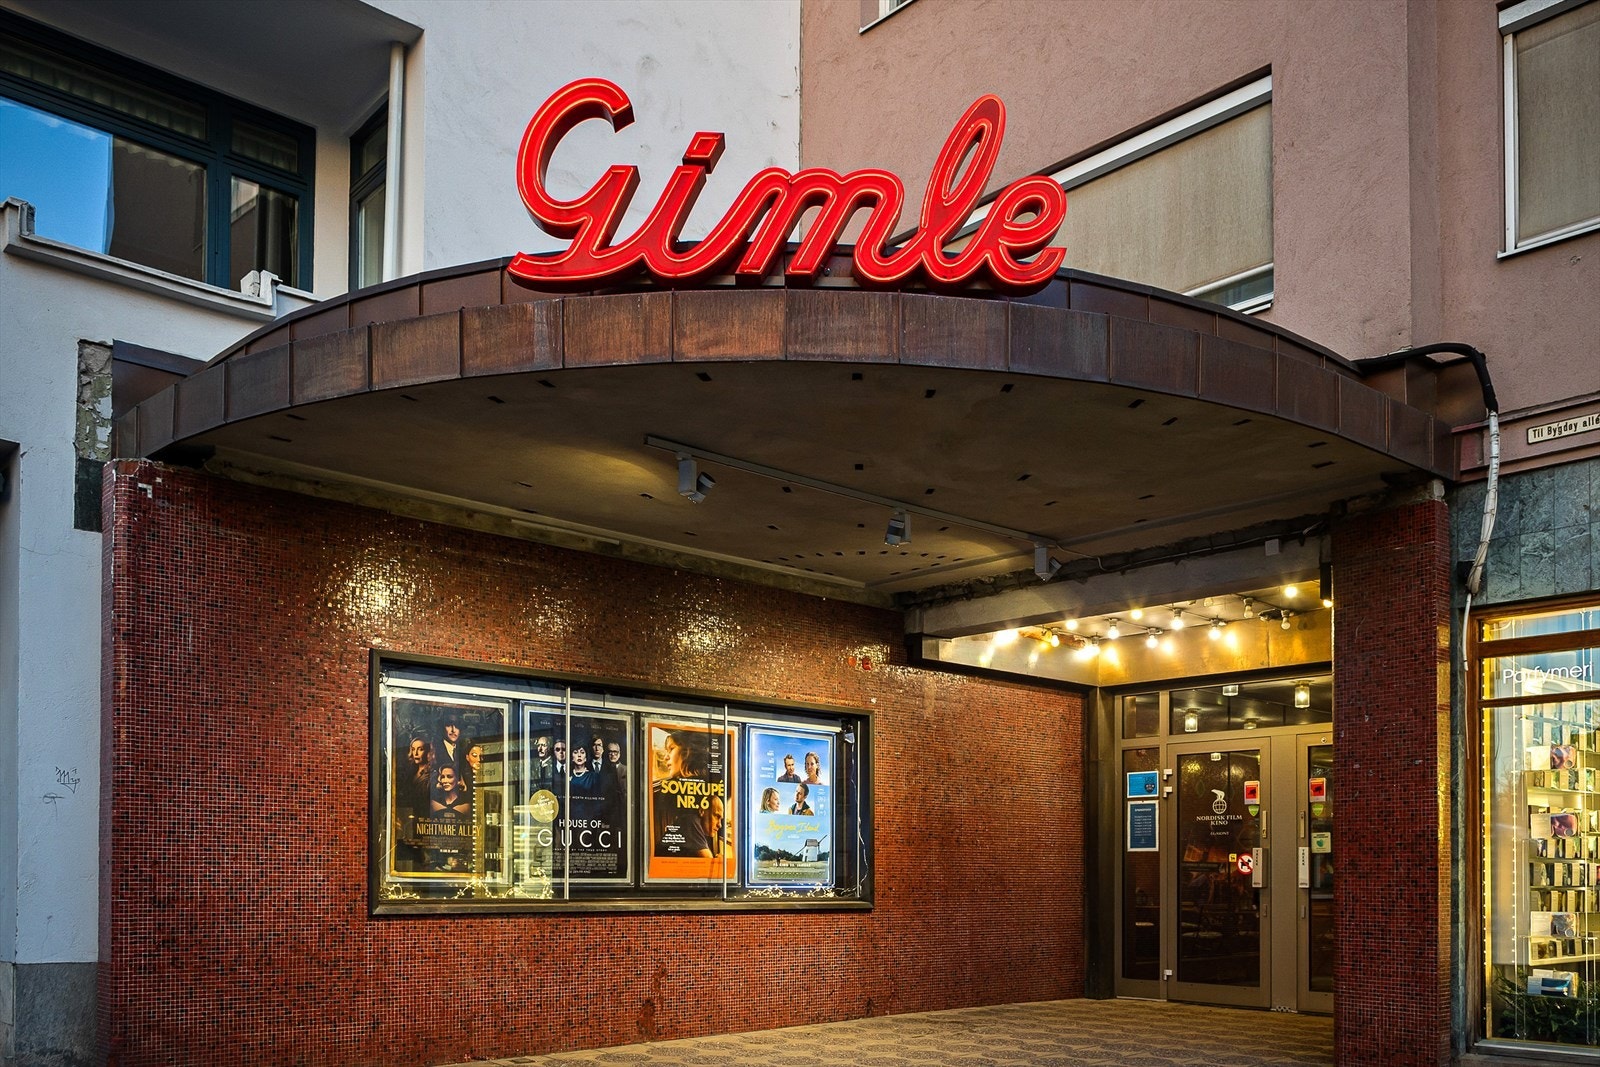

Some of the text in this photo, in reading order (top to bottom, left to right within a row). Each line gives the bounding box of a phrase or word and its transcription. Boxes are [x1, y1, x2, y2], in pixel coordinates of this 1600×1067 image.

[507, 78, 1068, 297] Gimle
[1532, 428, 1544, 438] Til
[1502, 661, 1592, 685] Parfymeri
[661, 780, 724, 796] SOVEKUPÉ
[677, 795, 709, 810] NR. 6
[416, 823, 457, 836] NIGHTMARE
[559, 819, 601, 828] HOUSE OF
[537, 828, 621, 848] GUCCI
